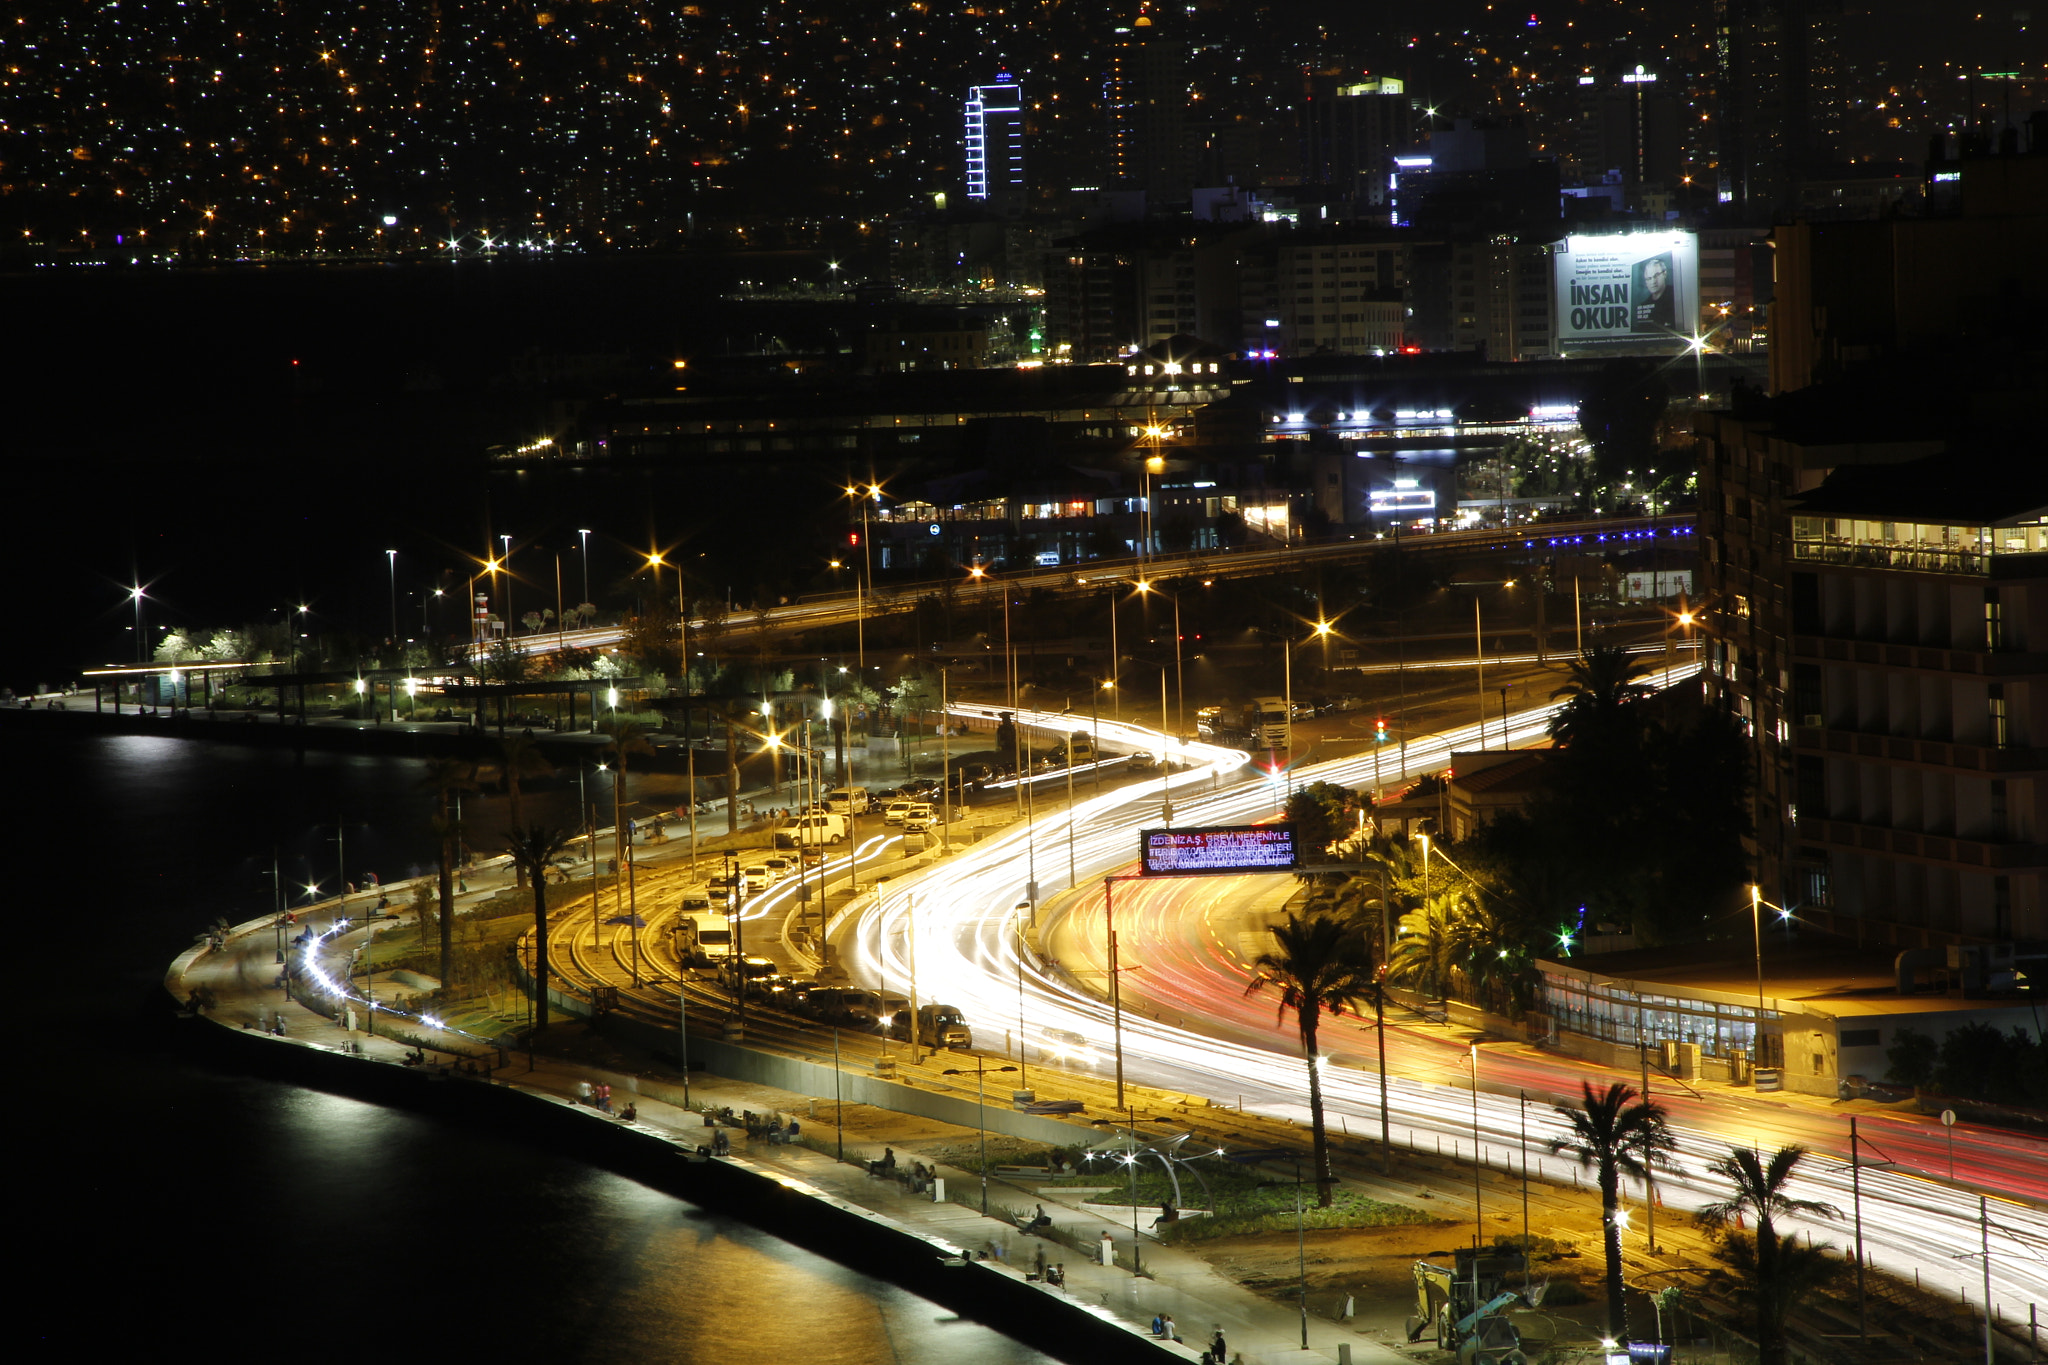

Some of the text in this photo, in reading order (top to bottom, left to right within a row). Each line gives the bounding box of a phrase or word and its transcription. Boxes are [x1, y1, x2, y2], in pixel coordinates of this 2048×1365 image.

[1570, 279, 1627, 305] İNSAN
[1571, 306, 1629, 330] OKUR
[1236, 830, 1290, 842] NEDENİYLE
